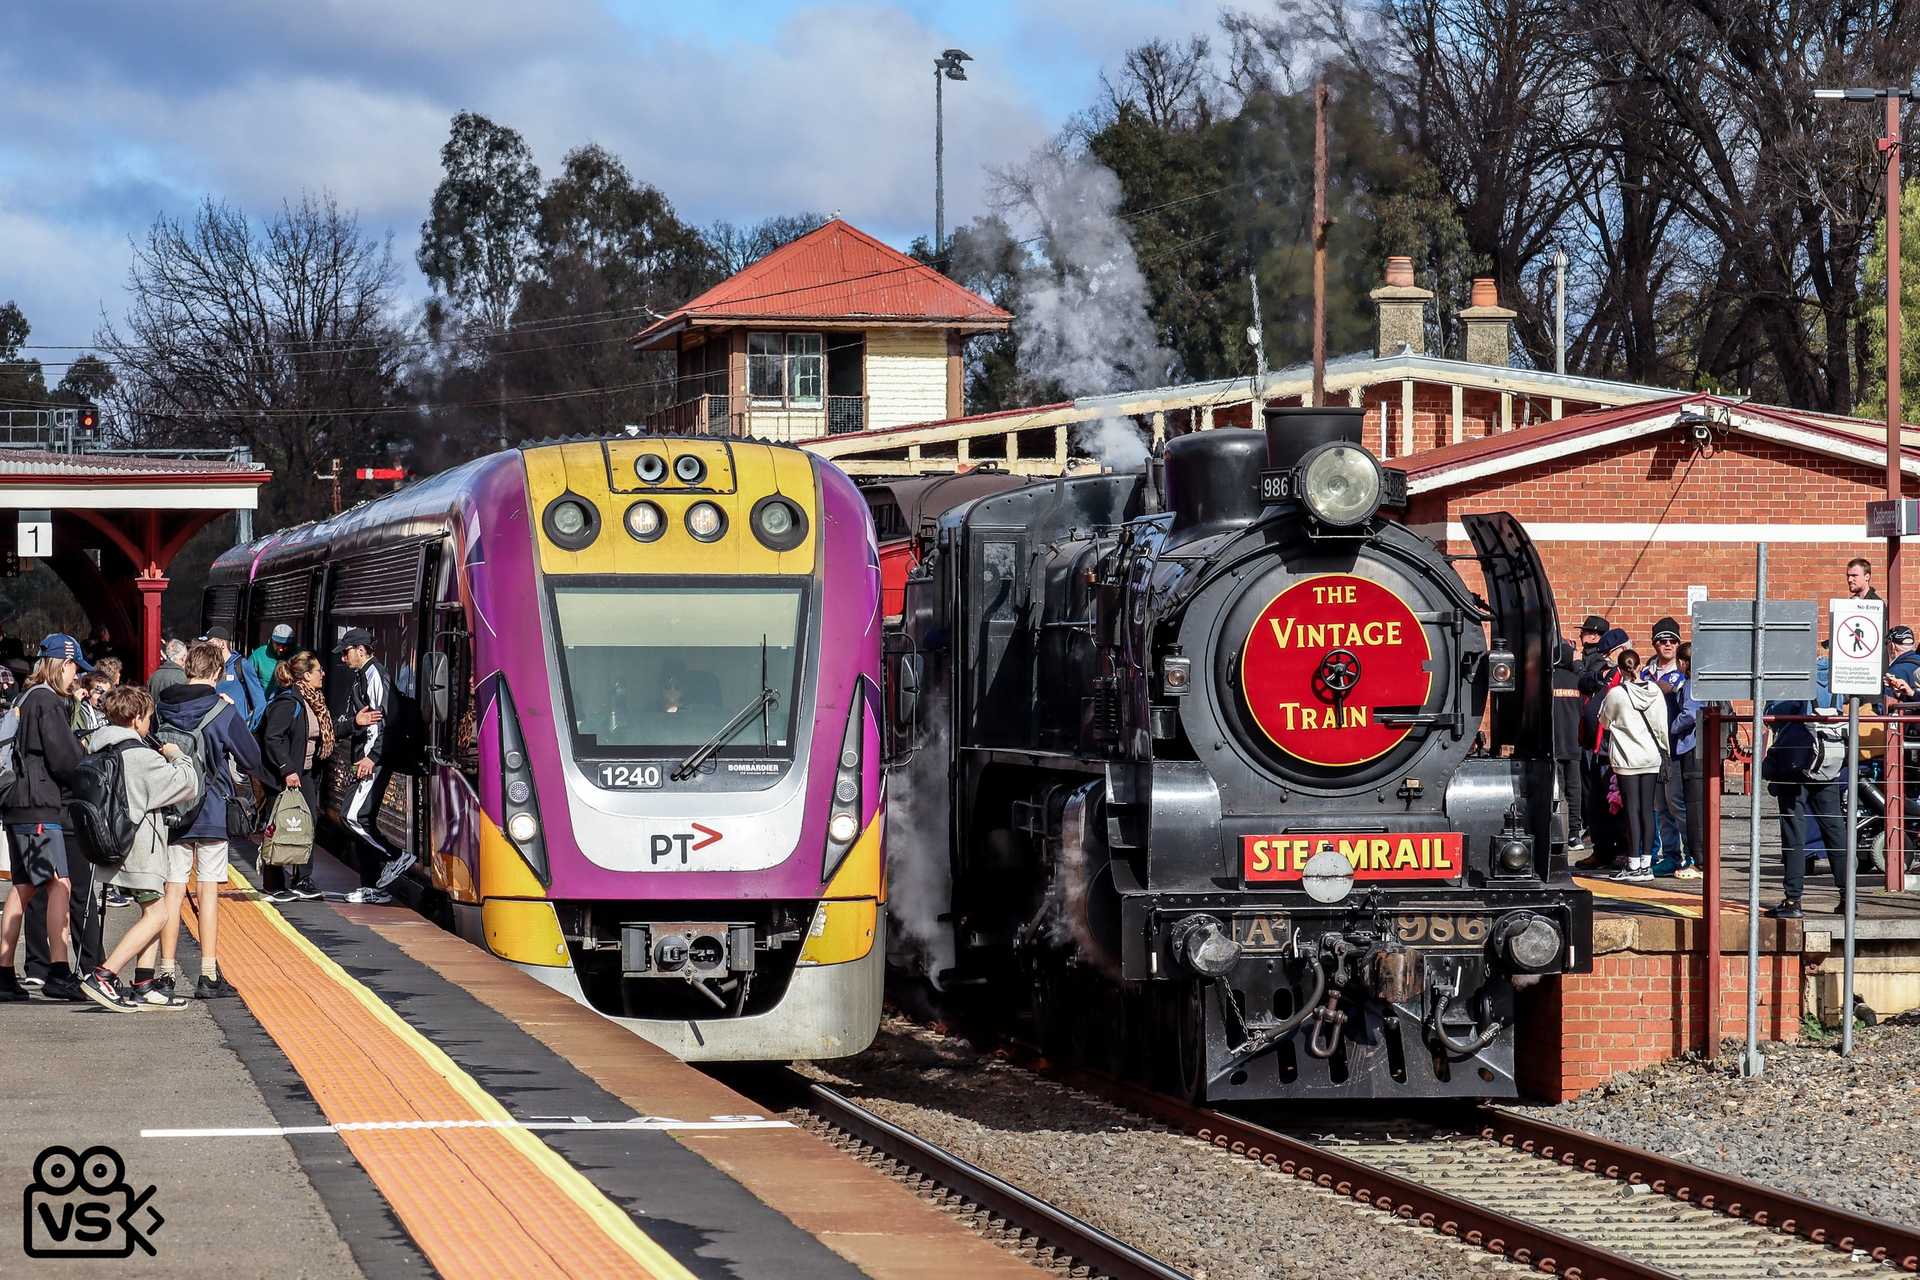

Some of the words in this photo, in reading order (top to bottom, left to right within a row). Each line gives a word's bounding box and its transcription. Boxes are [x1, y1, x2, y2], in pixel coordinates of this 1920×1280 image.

[1264, 477, 1289, 498] 986
[27, 525, 38, 553] 1
[1312, 585, 1357, 605] THE
[1268, 617, 1403, 649] VINTAGE
[1279, 702, 1368, 731] TRAIN
[602, 766, 660, 786] 1240
[1397, 911, 1486, 942] 986
